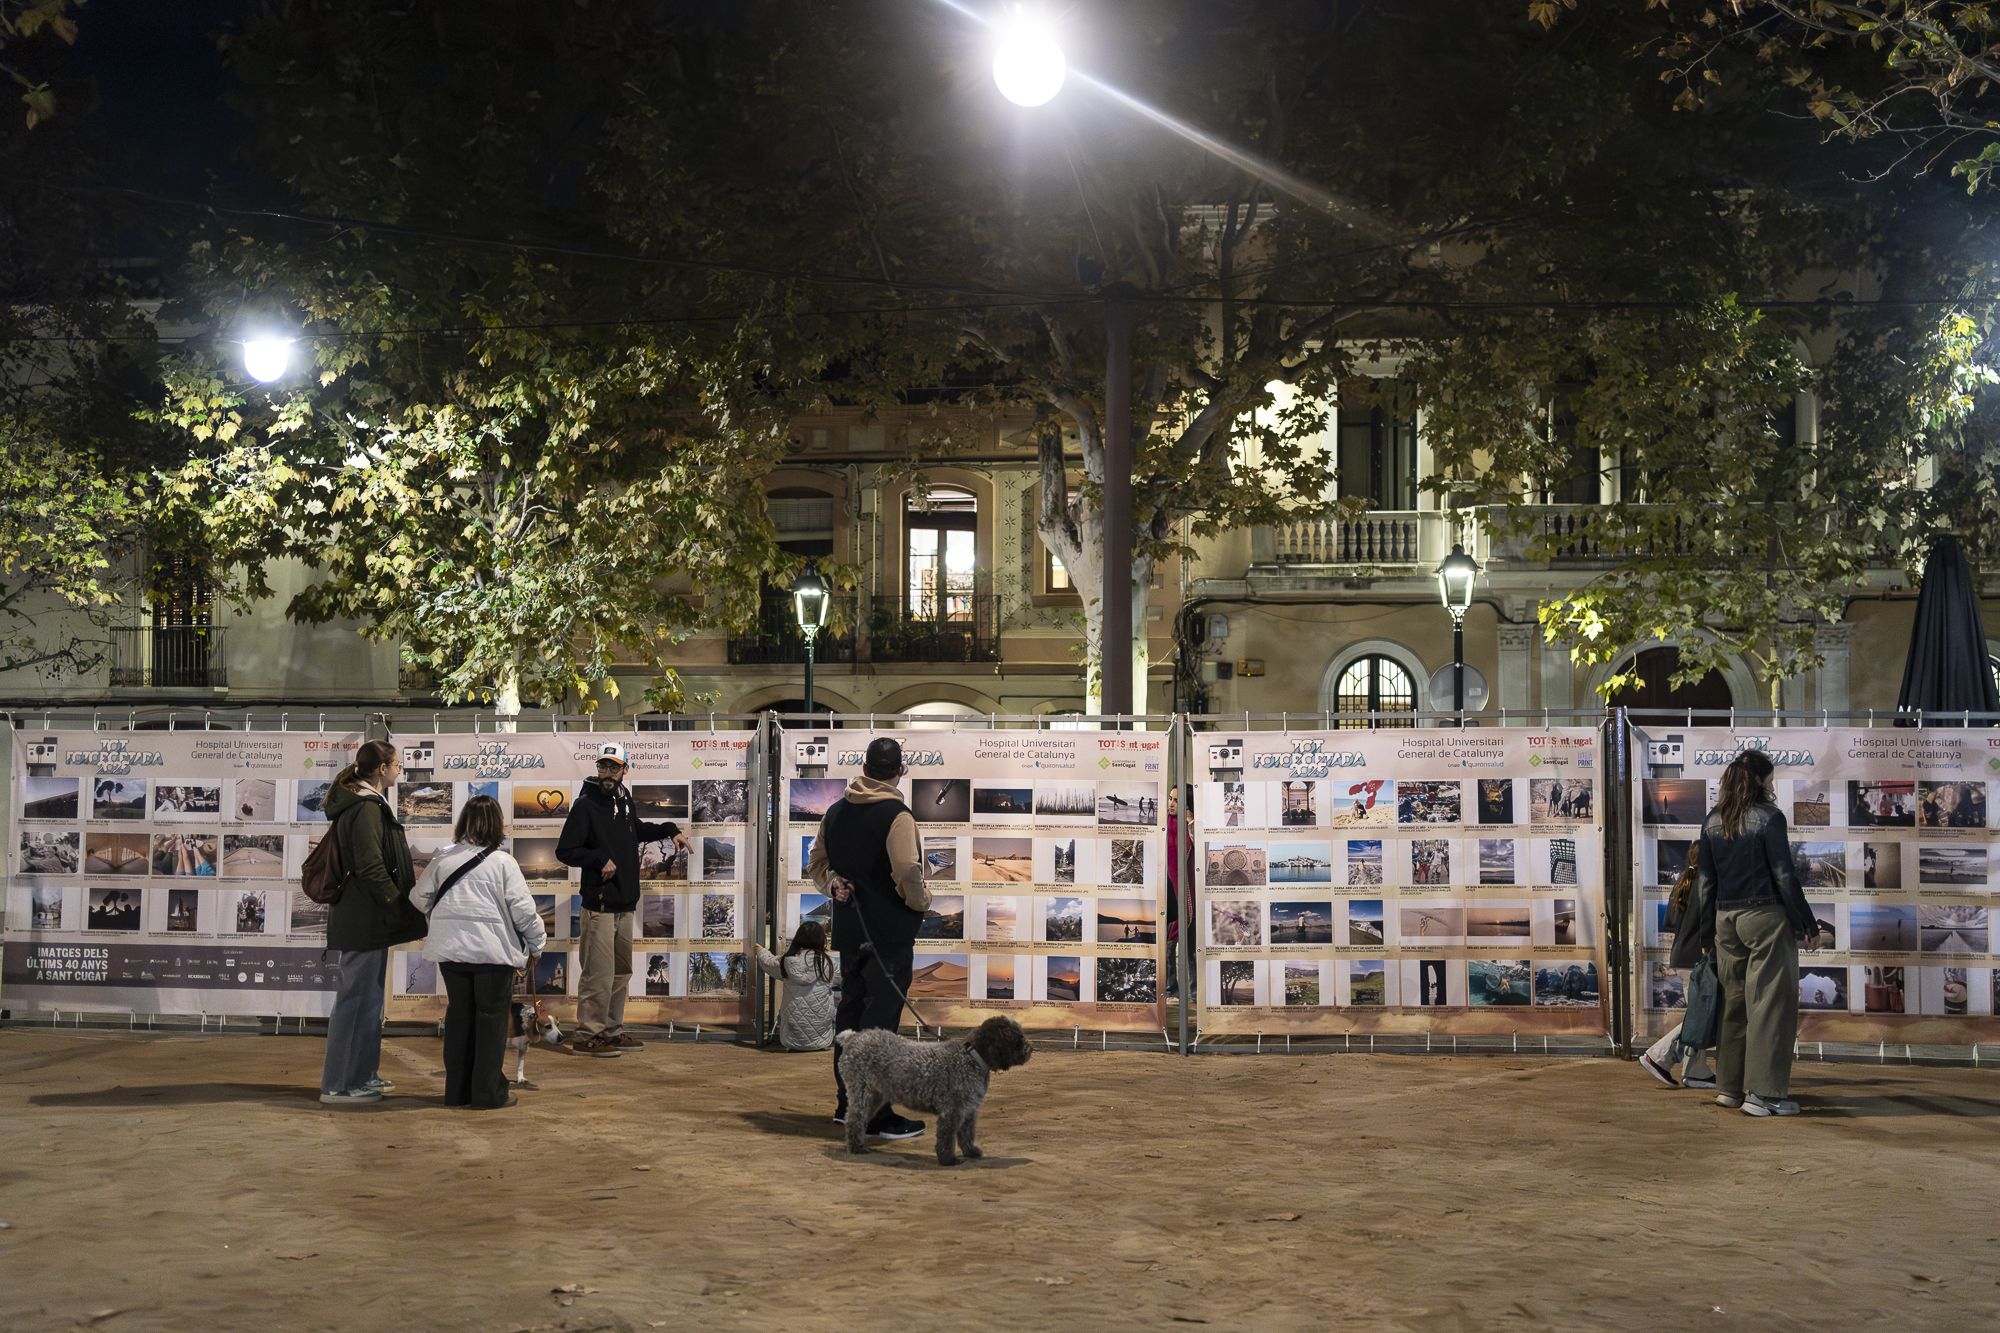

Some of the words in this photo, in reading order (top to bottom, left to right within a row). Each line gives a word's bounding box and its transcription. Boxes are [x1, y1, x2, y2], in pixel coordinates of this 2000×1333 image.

[100, 739, 129, 752] TOT
[196, 740, 232, 750] Hospital
[234, 740, 283, 750] Universitari
[980, 739, 1018, 748] Hospital
[1022, 738, 1076, 748] Universitari
[1291, 739, 1324, 753] TOT
[1403, 738, 1444, 748] Hospital
[1448, 737, 1504, 747] Universitari
[1734, 736, 1770, 752] TOT
[1854, 738, 1897, 747] Hospital
[1900, 738, 1961, 747] Universitari
[478, 742, 508, 755] TOT
[1398, 750, 1436, 758] General
[1439, 748, 1450, 758] de
[1454, 748, 1504, 759] Catalunya
[192, 751, 228, 760] General
[226, 750, 236, 760] de
[238, 751, 282, 761] Catalunya
[974, 750, 1011, 759] General
[1014, 750, 1024, 758] de
[1027, 750, 1075, 760] Catalunya
[1848, 750, 1888, 759] General
[1892, 750, 1904, 758] de
[1908, 750, 1961, 760] Catalunya
[476, 764, 511, 778] 2025
[1290, 762, 1328, 778] 2025
[38, 948, 80, 958] IMATGES
[84, 948, 108, 958] DELS
[26, 956, 62, 968] ÚLTIMS
[66, 960, 78, 969] 40
[81, 960, 108, 970] ANYS
[36, 970, 44, 980] A
[46, 971, 71, 980] SANT
[74, 972, 108, 981] CUGAT
